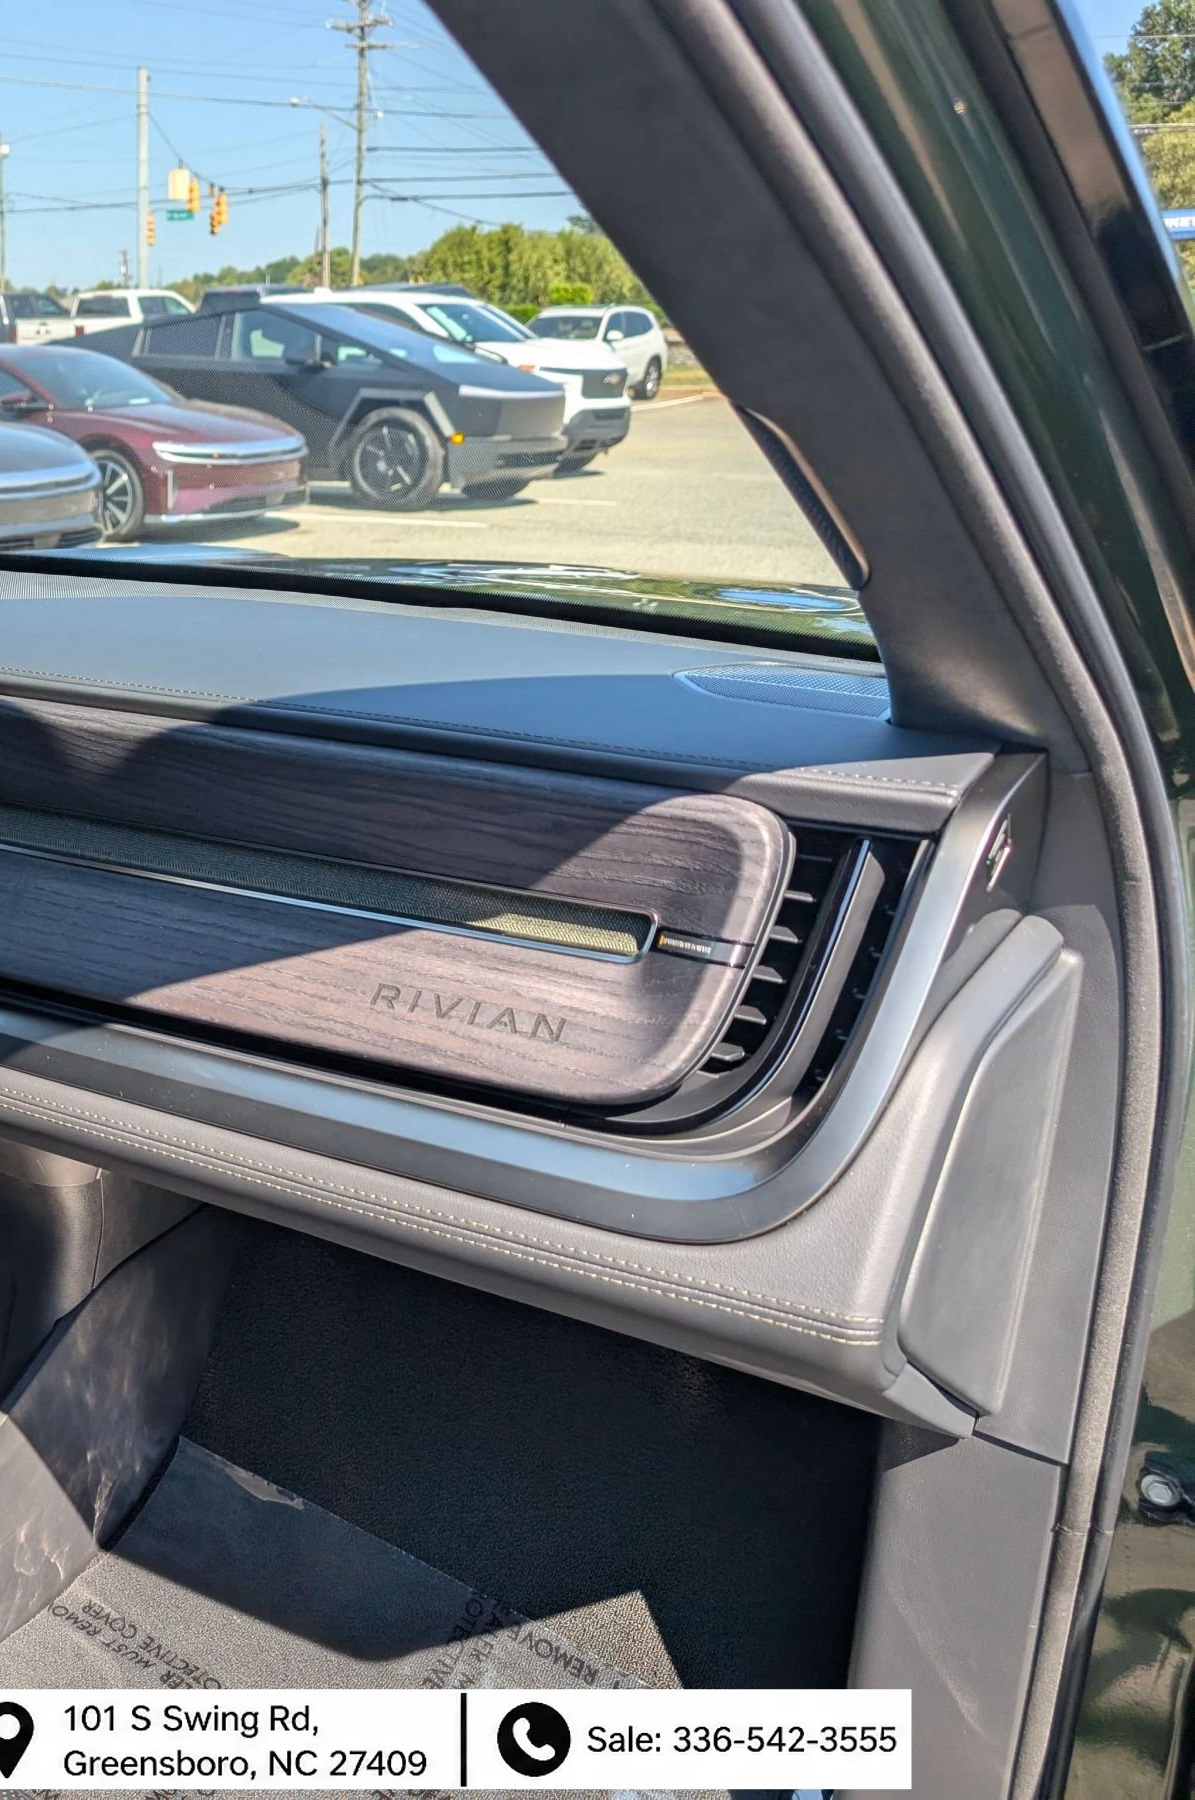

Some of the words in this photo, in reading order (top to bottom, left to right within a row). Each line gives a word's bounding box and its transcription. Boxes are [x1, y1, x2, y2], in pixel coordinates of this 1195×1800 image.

[370, 982, 567, 1042] RIVIAN
[48, 1603, 103, 1637] REMO
[82, 1599, 138, 1640] COVER
[100, 1639, 155, 1669] MUST
